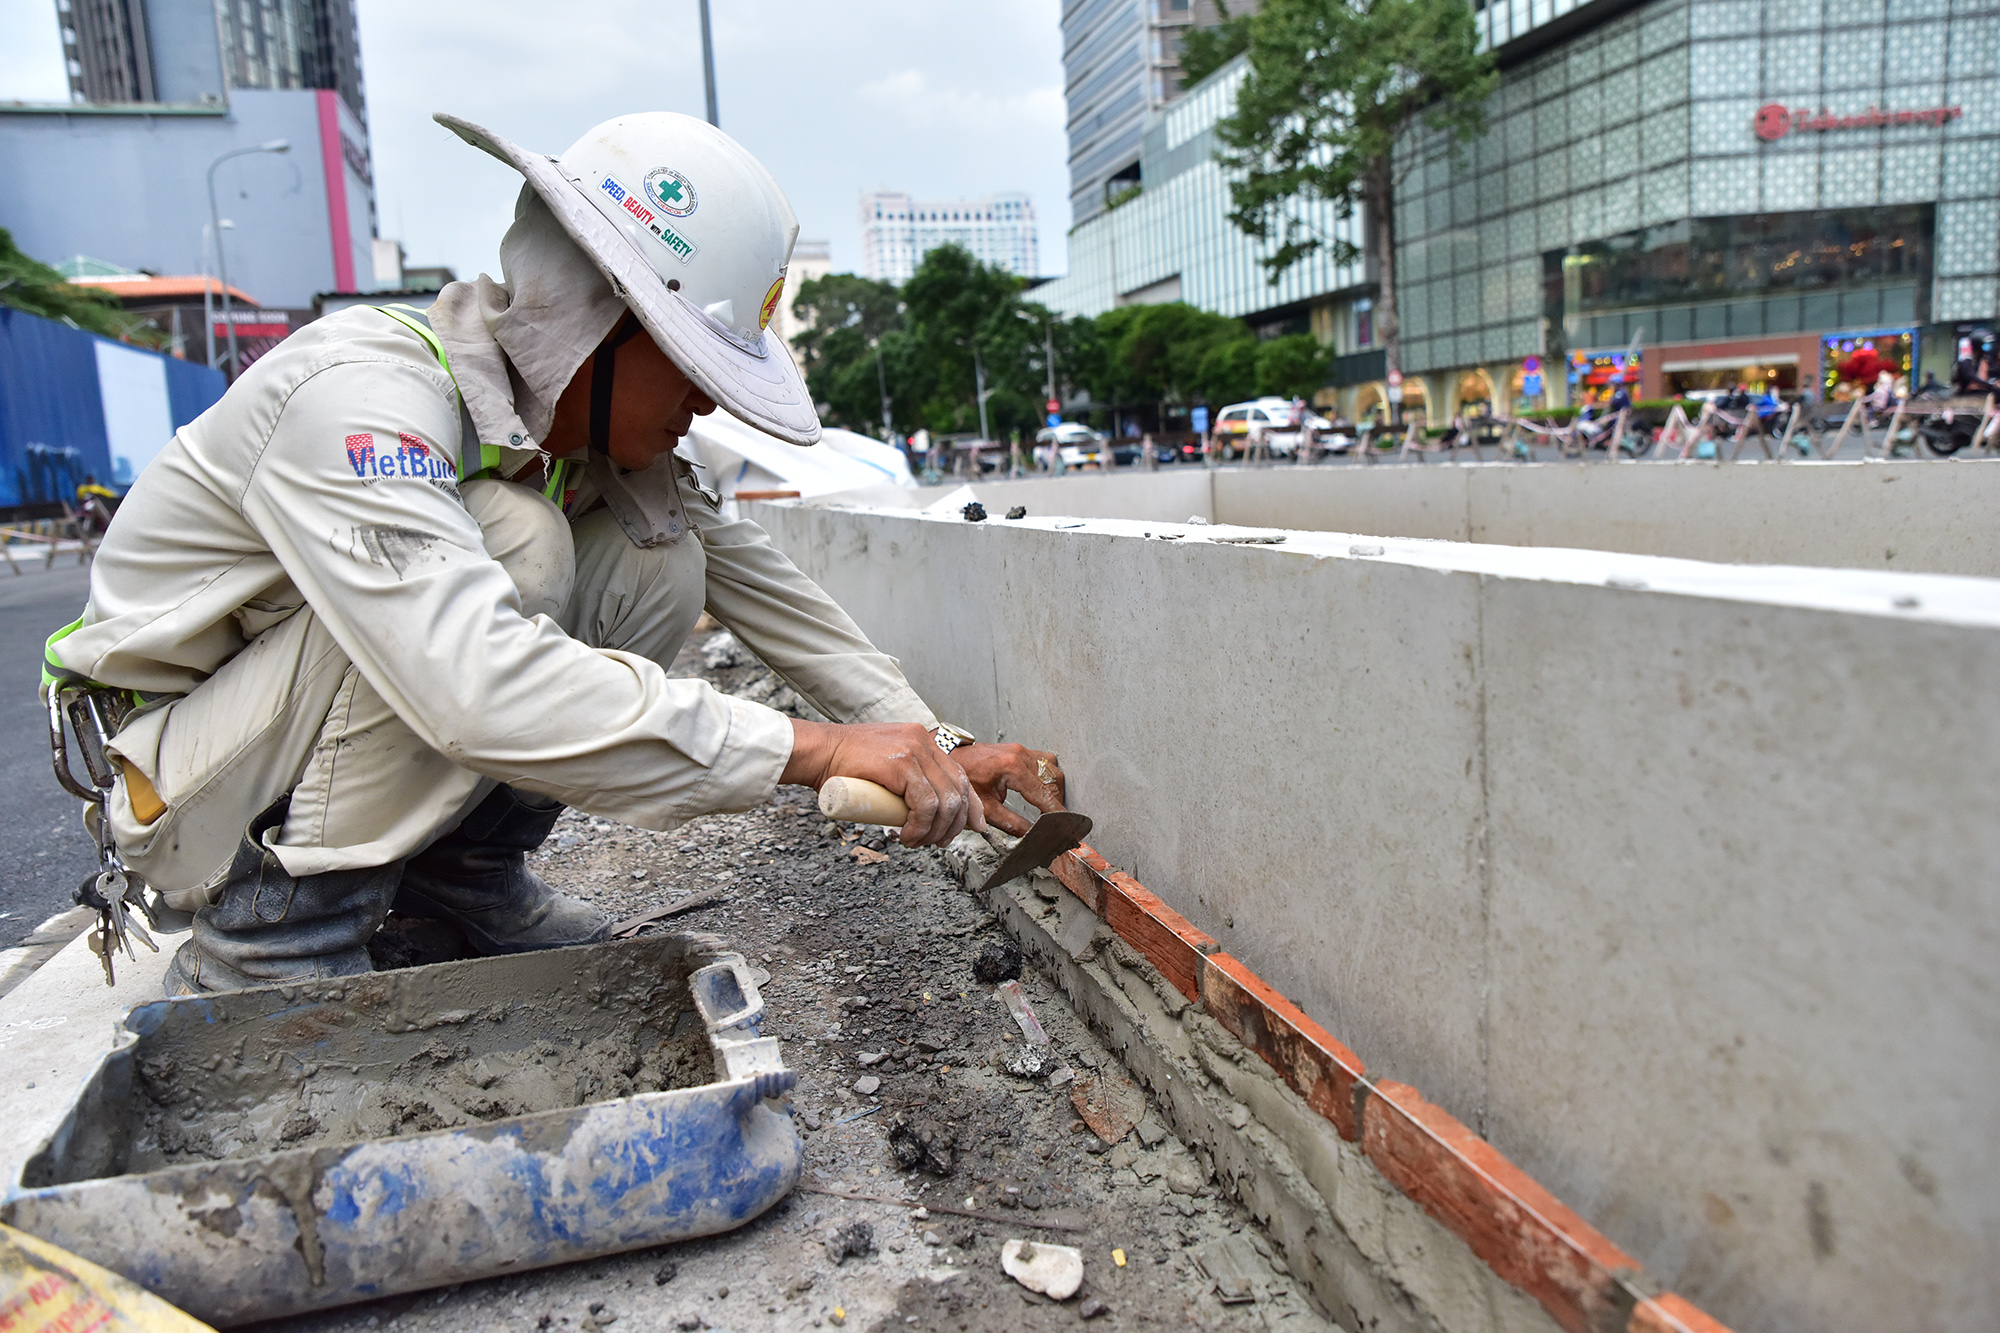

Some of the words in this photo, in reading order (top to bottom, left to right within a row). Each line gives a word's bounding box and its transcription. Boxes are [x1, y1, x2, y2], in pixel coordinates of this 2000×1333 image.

[602, 178, 626, 205] SPEED,
[623, 196, 655, 225] BEAUTY
[650, 223, 662, 236] WITH
[660, 228, 693, 258] SAFETY
